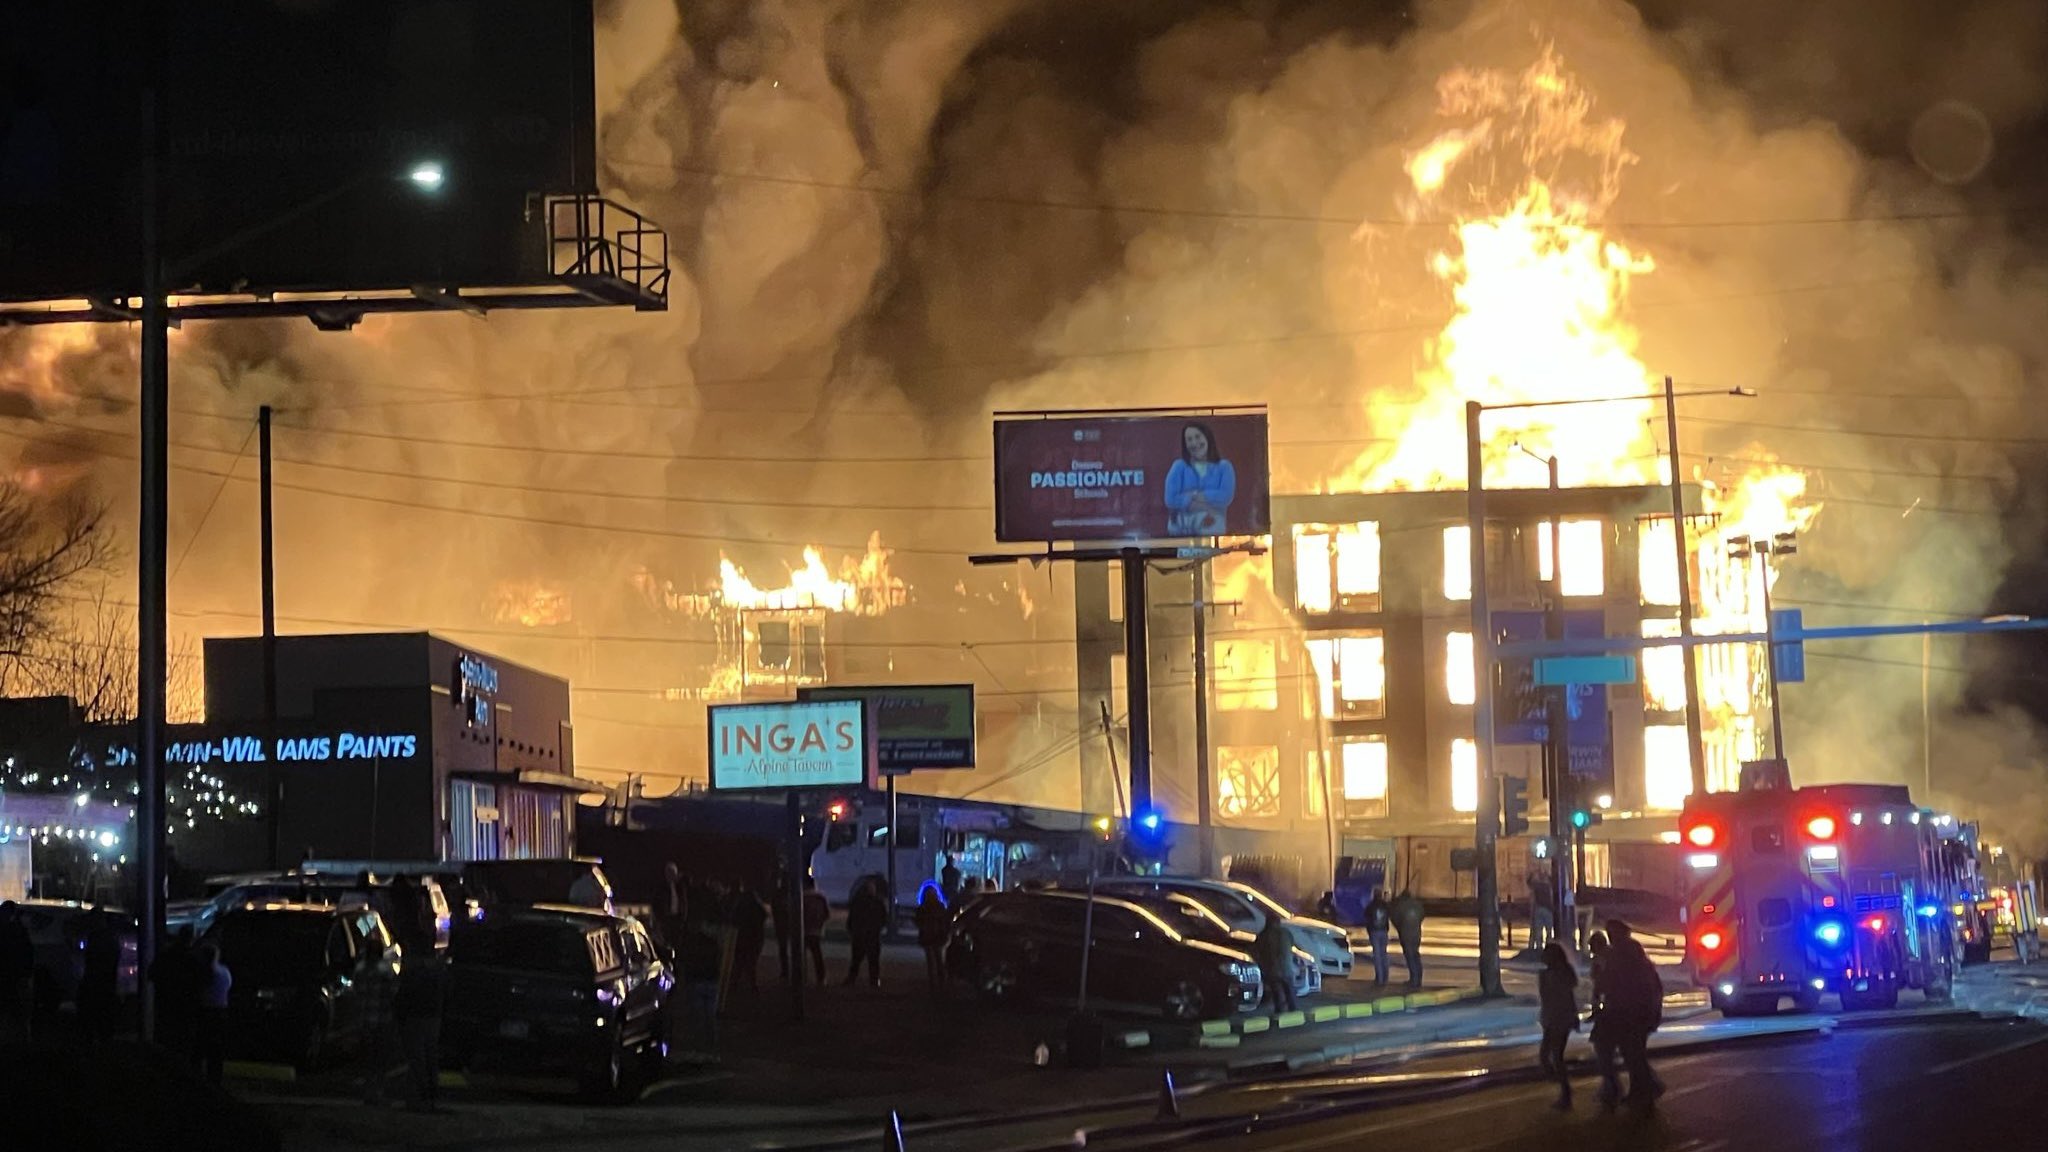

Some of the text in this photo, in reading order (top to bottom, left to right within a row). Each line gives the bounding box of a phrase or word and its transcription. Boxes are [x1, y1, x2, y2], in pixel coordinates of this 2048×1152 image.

[1031, 470, 1144, 488] PASSIONATE
[337, 733, 416, 760] PAINTS
[722, 721, 854, 756] INGA'S
[744, 757, 833, 779] Alpine Tavern
